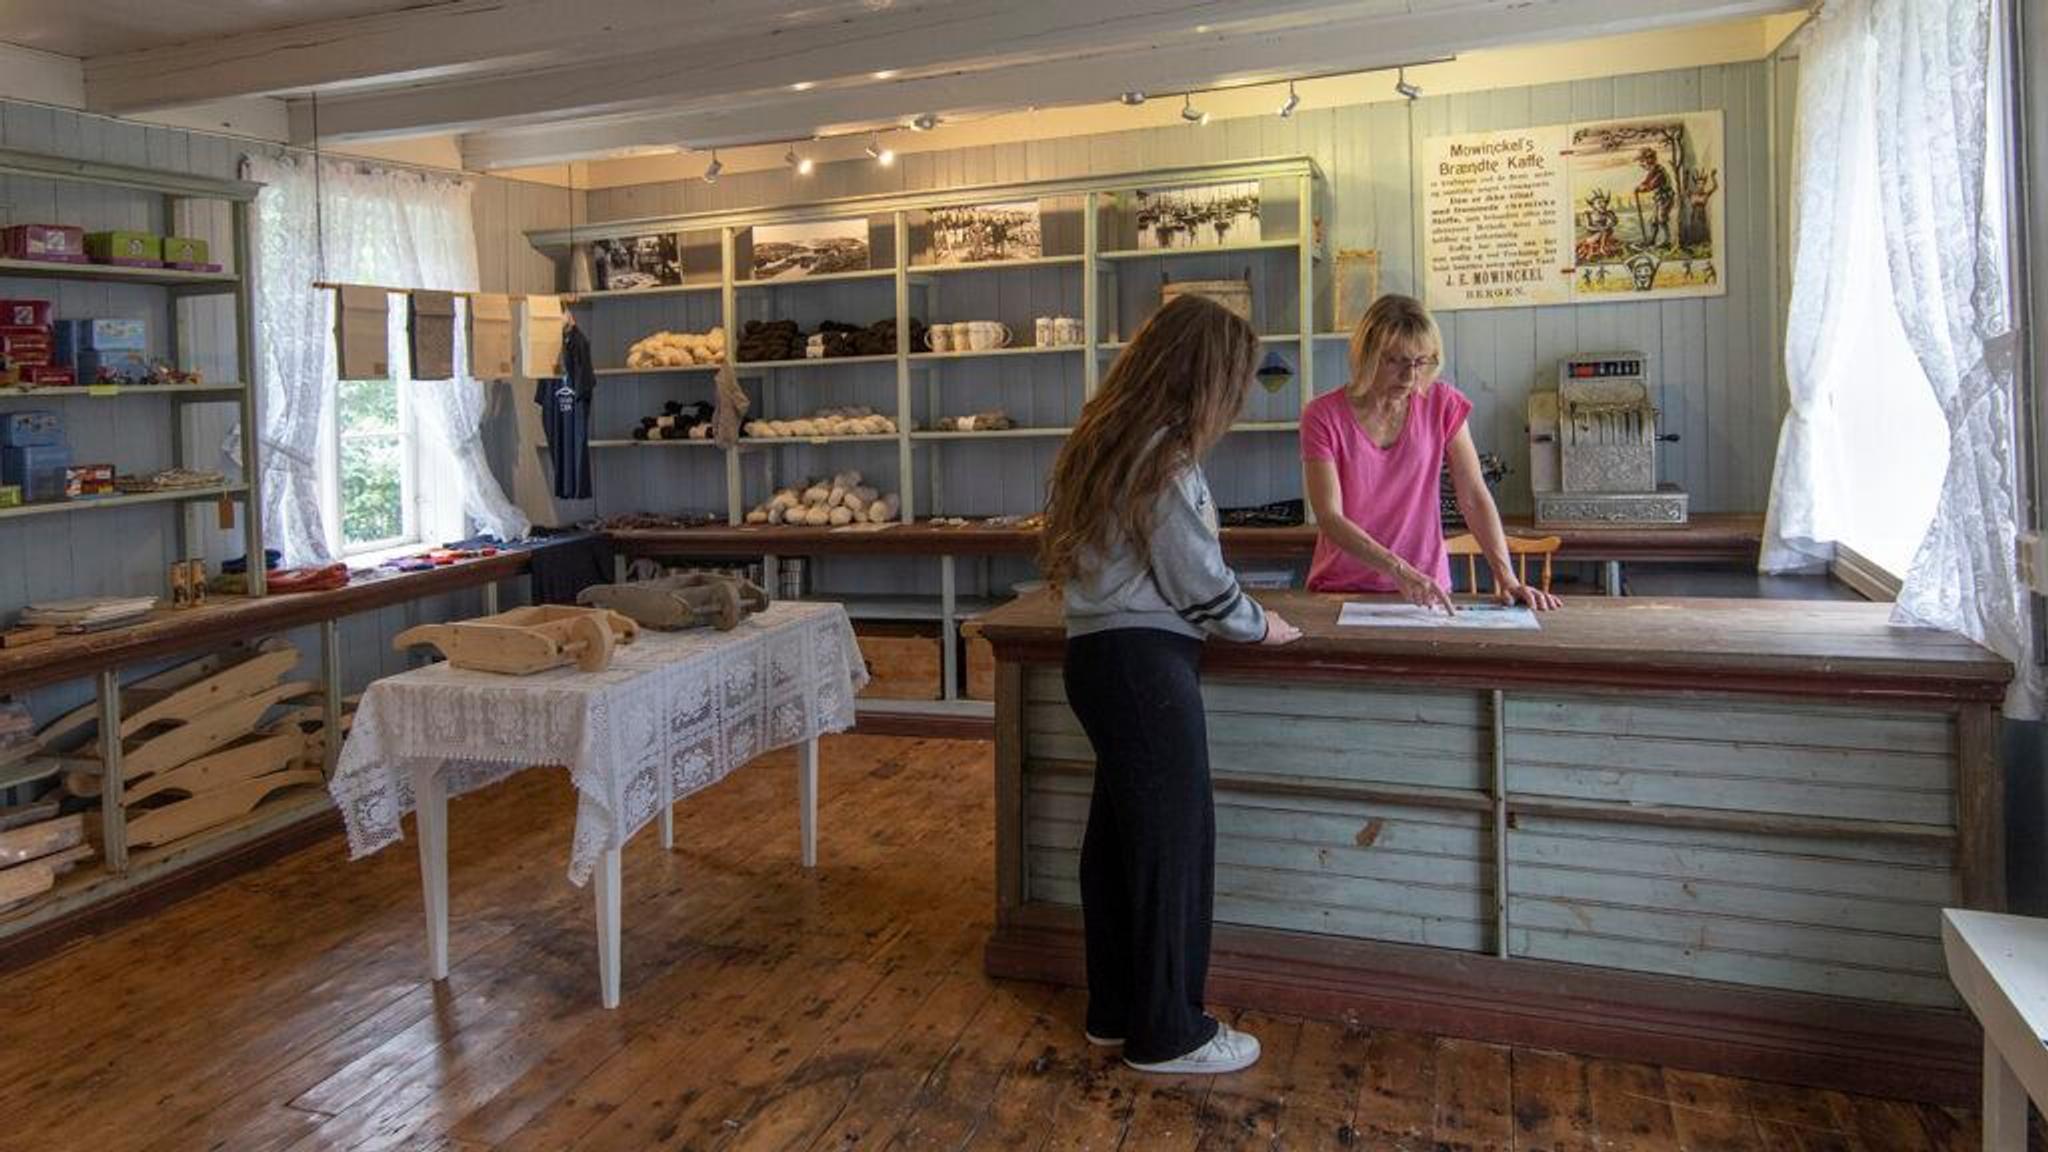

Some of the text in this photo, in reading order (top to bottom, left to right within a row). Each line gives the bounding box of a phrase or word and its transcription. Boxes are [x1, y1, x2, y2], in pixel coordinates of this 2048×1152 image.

[1450, 138, 1534, 157] Mowinckel's
[1440, 154, 1544, 176] Brændte Kaffe
[1474, 268, 1544, 285] MOWINCKEL
